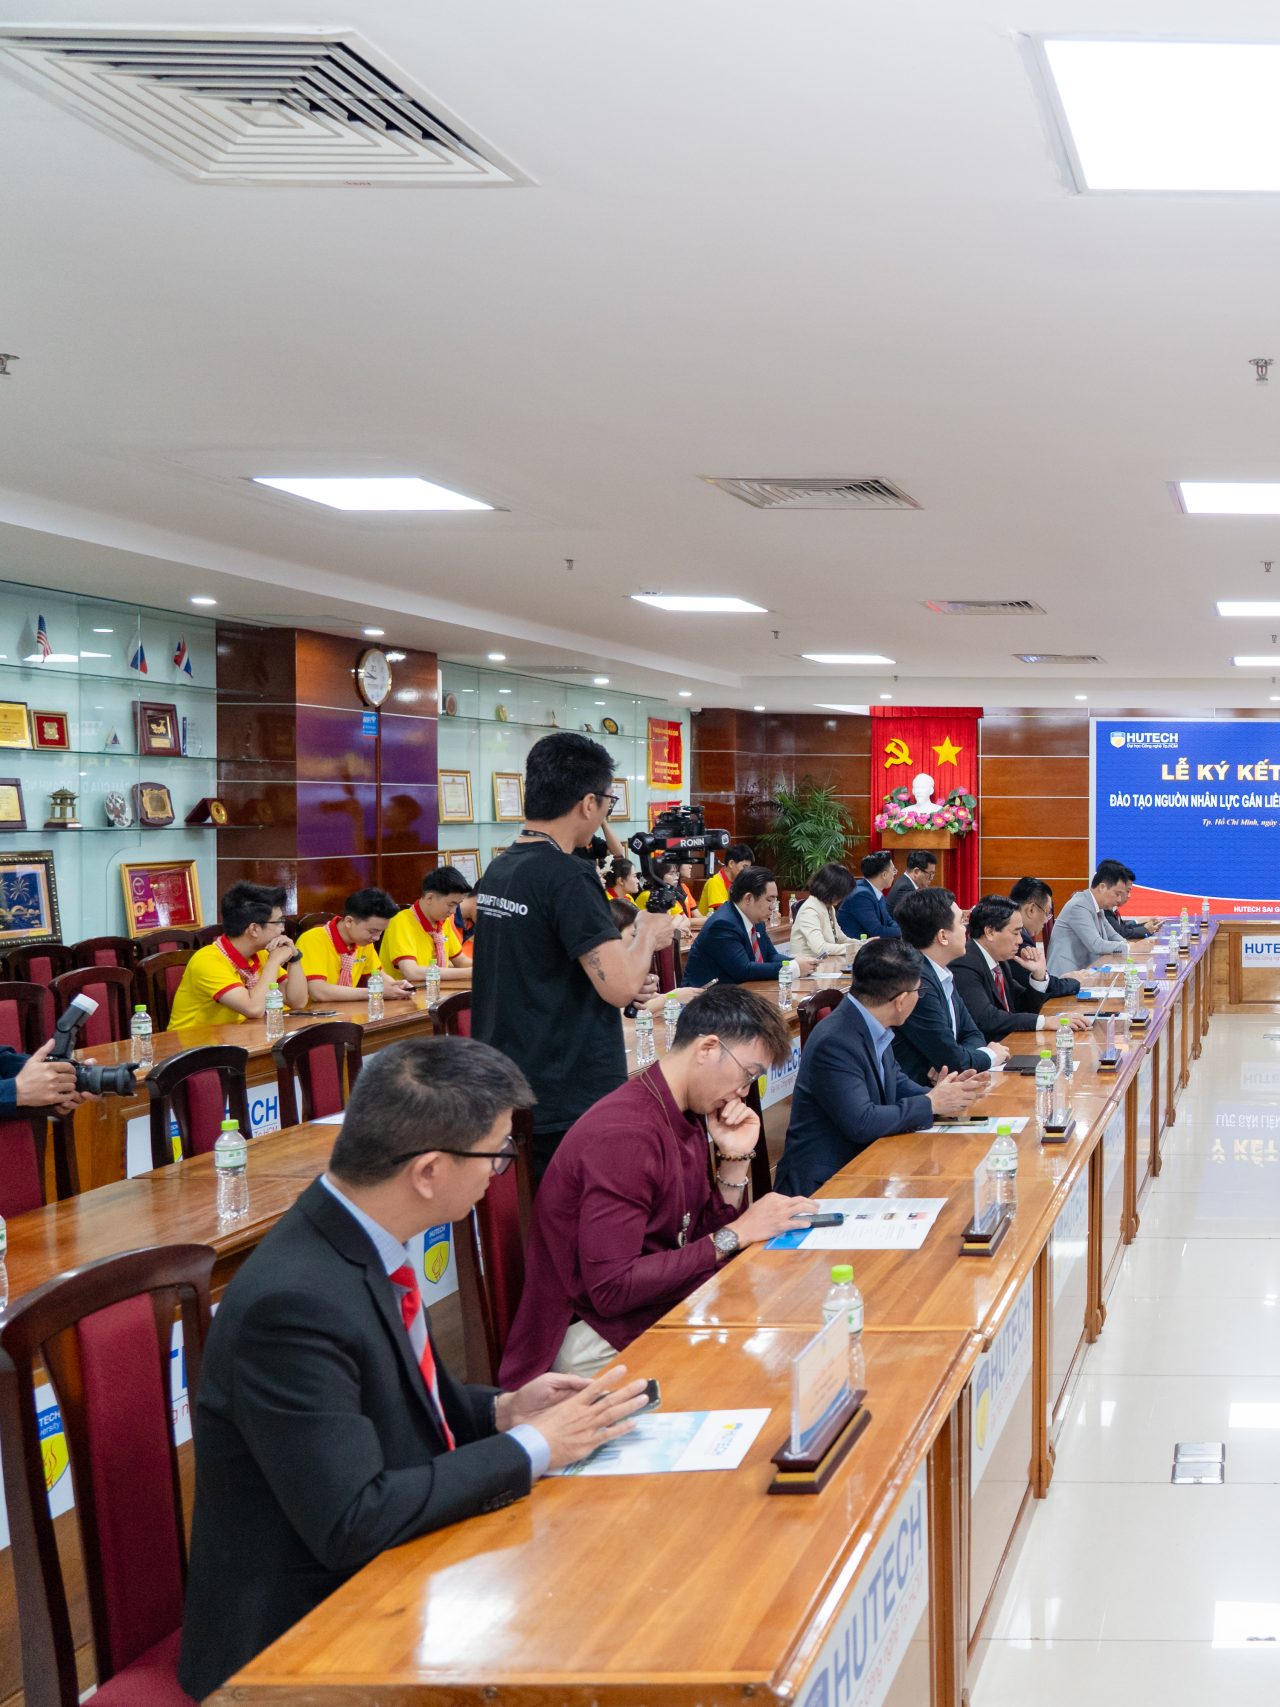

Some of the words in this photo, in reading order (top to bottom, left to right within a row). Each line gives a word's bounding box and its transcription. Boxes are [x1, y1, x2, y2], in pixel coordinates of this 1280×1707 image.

[1126, 732, 1178, 743] HUTECH
[1161, 757, 1190, 781] LỄ
[1197, 760, 1230, 781] KÝ
[1109, 790, 1131, 807] ĐÀO
[1133, 794, 1152, 810] TẠO
[1191, 791, 1217, 808] NHÂN
[1220, 794, 1240, 810] LỰC
[680, 838, 705, 847] RONIN
[990, 1281, 1031, 1401] HUTECH
[39, 1410, 61, 1427] TECH
[833, 1487, 922, 1707] HUTECH
